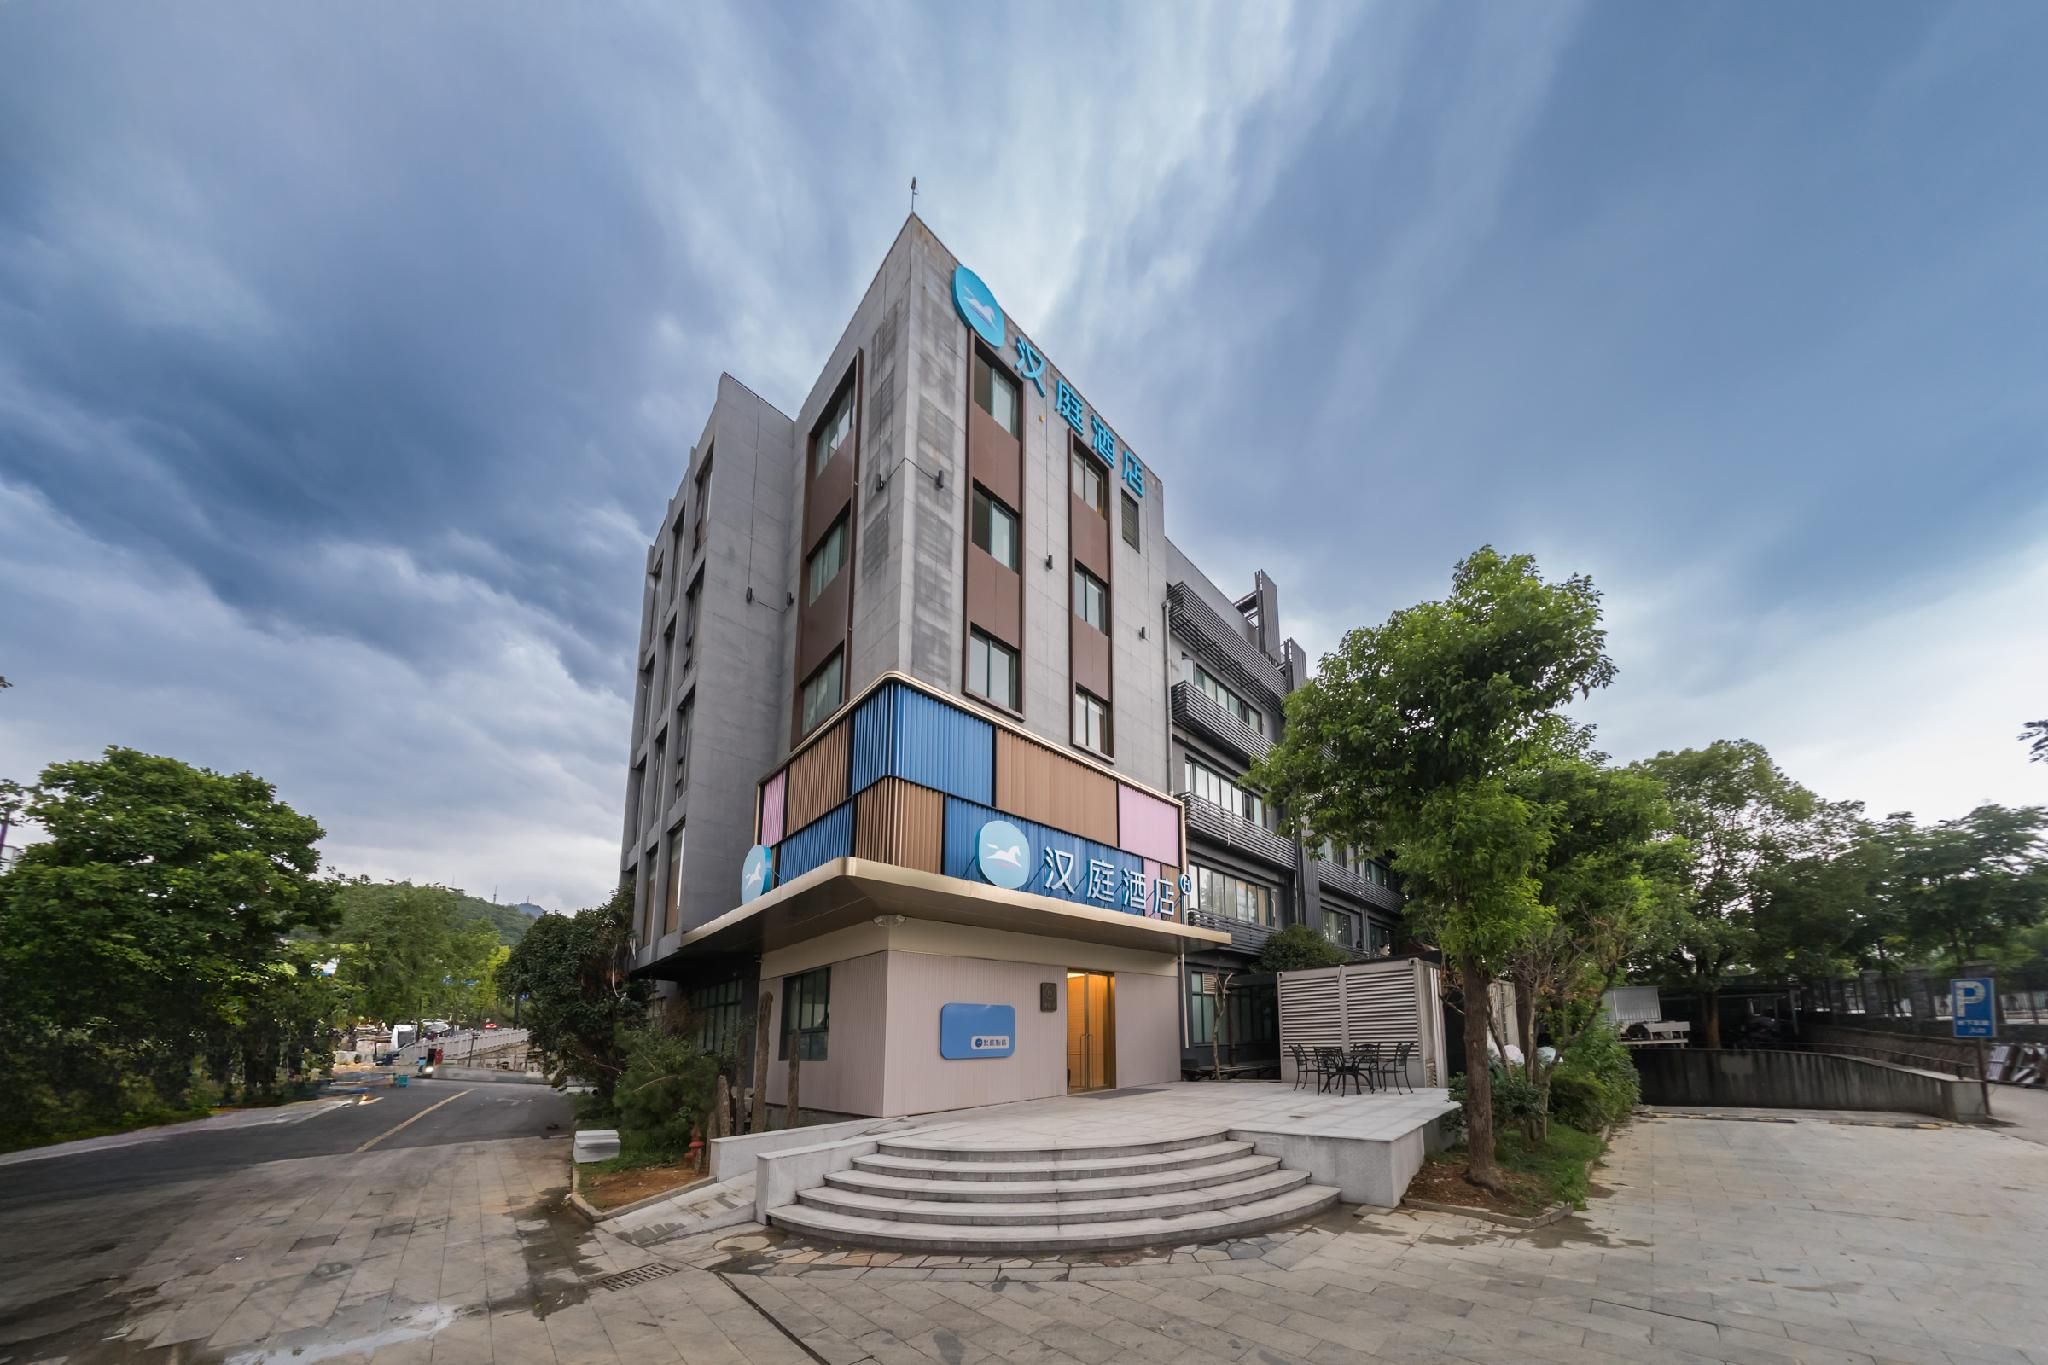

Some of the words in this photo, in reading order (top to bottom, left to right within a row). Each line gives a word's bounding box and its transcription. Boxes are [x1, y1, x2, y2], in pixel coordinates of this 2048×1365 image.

[1014, 335, 1145, 498] 汉庭酒店
[1043, 846, 1175, 917] 汉庭酒店
[1955, 981, 1985, 1018] P
